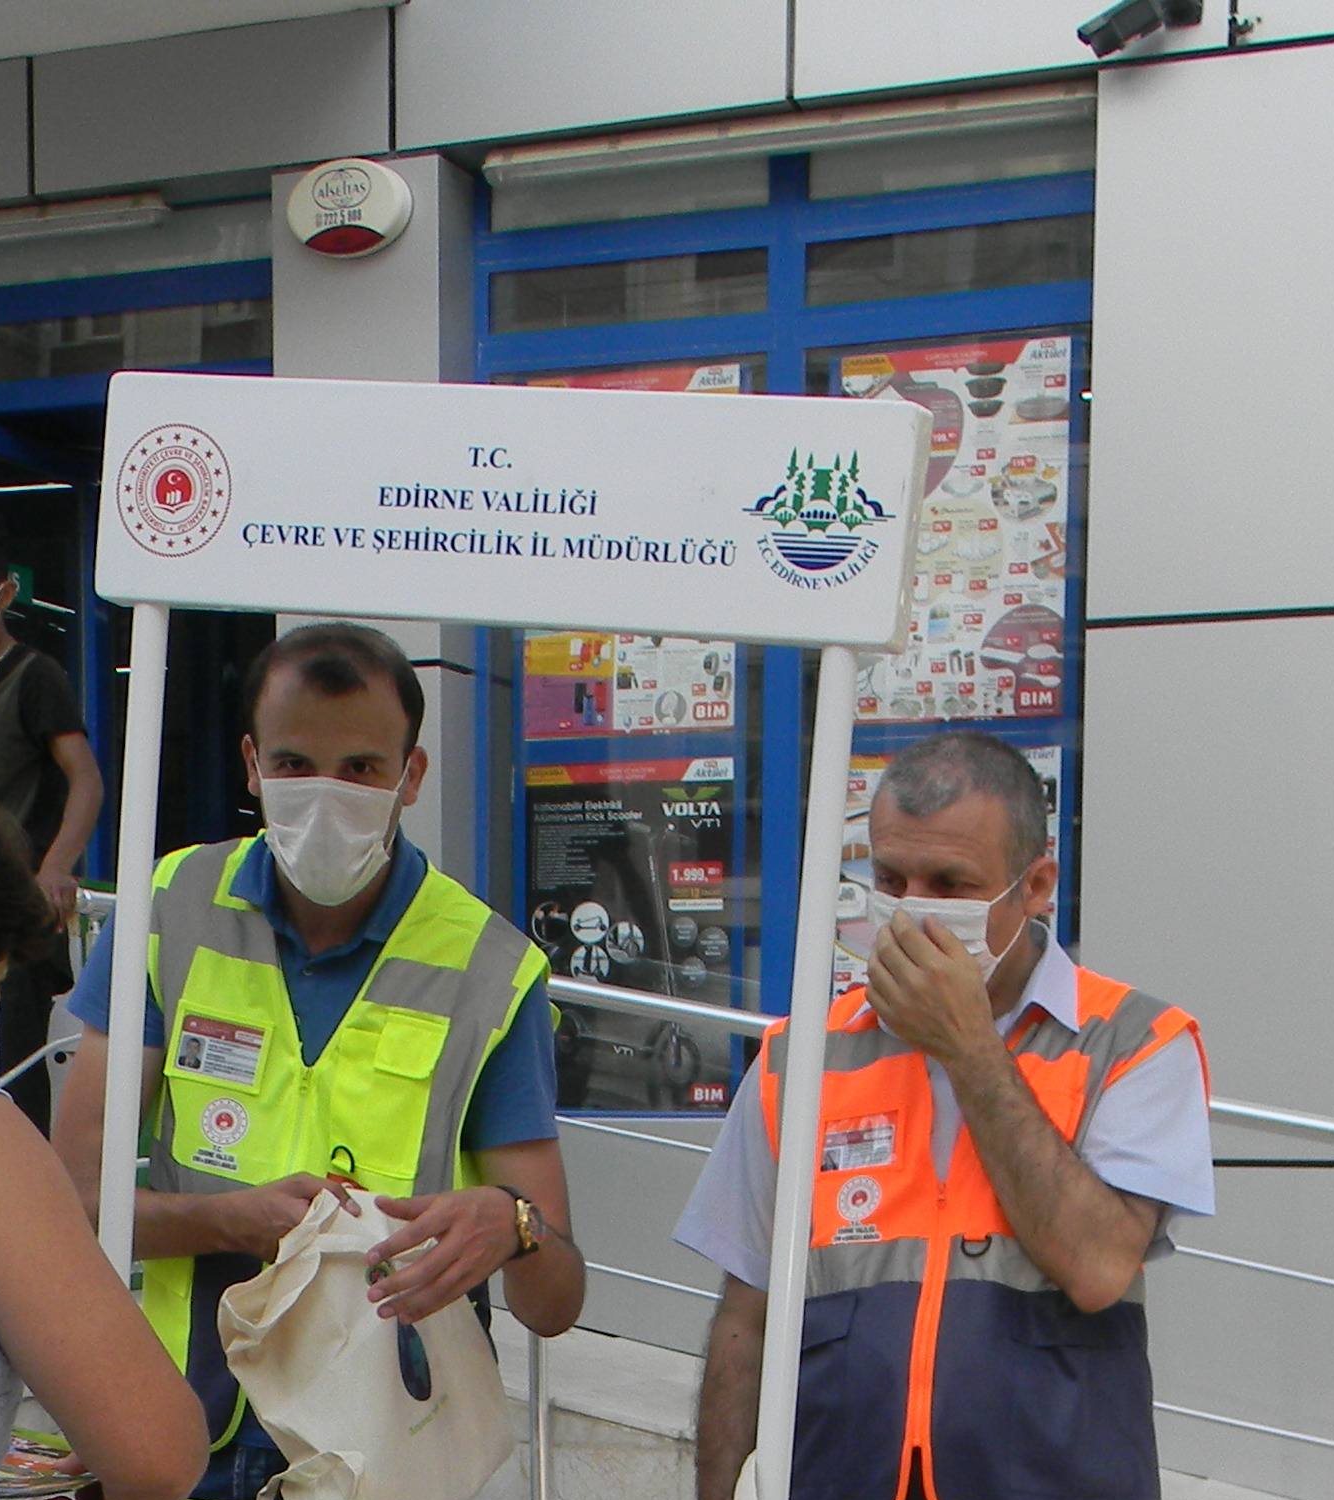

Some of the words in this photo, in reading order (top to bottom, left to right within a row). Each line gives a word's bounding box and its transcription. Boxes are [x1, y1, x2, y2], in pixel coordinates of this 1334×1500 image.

[469, 446, 513, 469] T.C.
[378, 482, 474, 511] EDİRNE
[482, 487, 599, 516] VALİLİĞİ
[242, 522, 326, 549] ÇEVRE
[333, 527, 366, 549] VE
[372, 525, 523, 556] ŞEHİRCİLİK
[531, 531, 556, 558] İL
[562, 533, 738, 567] MÜDÜRLÜĞÜ
[756, 535, 774, 565] T.C.
[769, 559, 822, 590] EDİRNE
[822, 538, 879, 589] VALİLİĞİ
[662, 801, 722, 816] VOLTA
